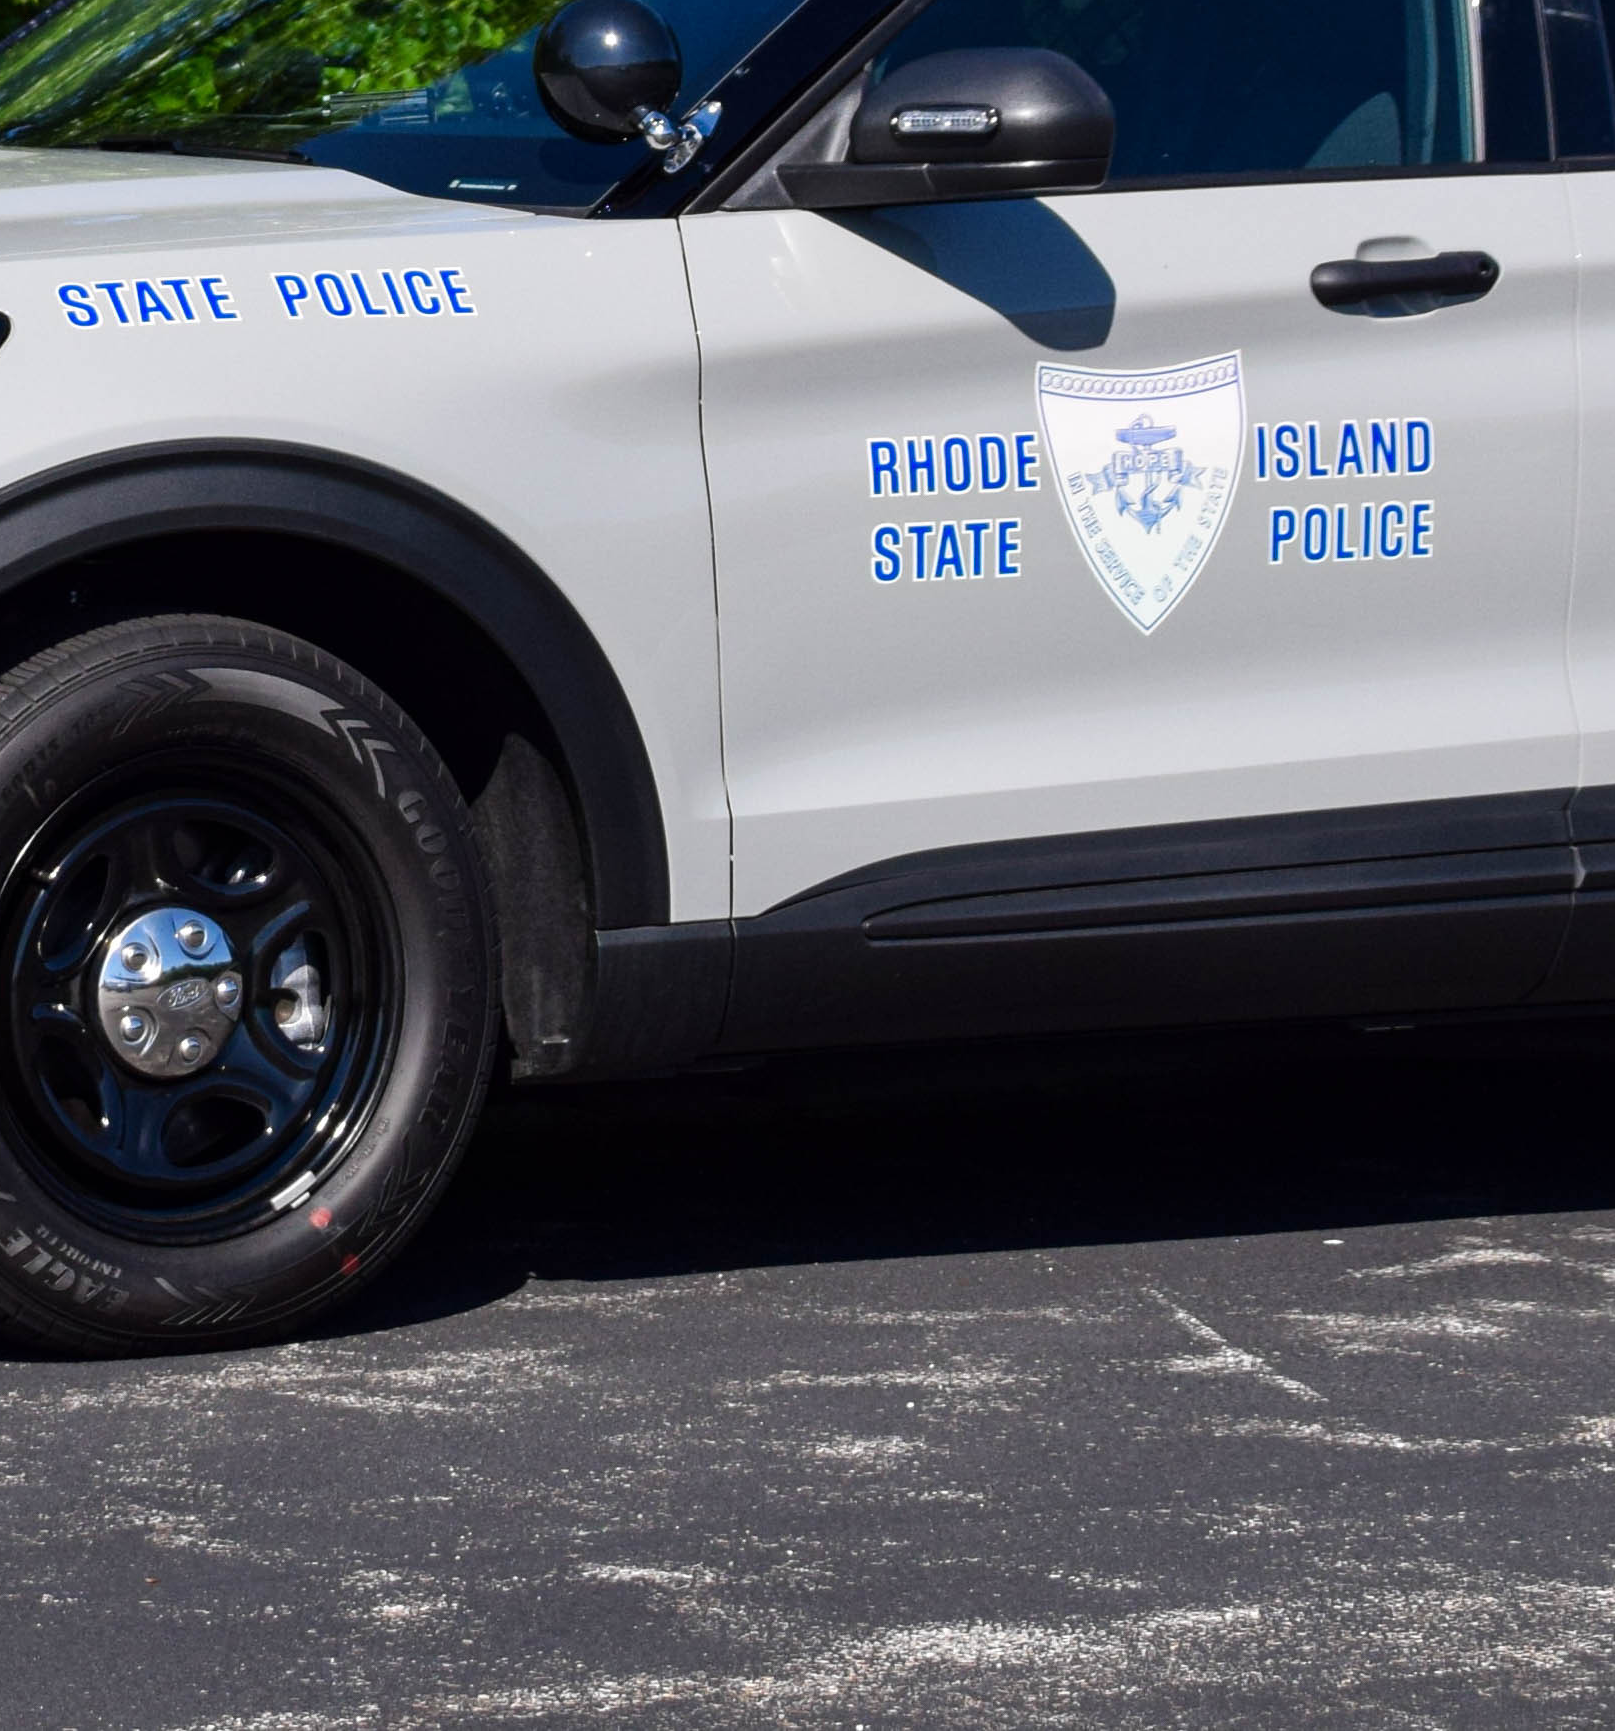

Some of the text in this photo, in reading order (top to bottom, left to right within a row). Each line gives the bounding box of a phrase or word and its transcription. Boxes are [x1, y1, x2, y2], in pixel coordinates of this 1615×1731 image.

[56, 268, 475, 328] STATE POLICE
[869, 420, 1432, 496] RHODE ISLAND
[1066, 471, 1086, 496] IN
[1120, 451, 1171, 469] HOPE
[873, 502, 1431, 583] STATE POLICE
